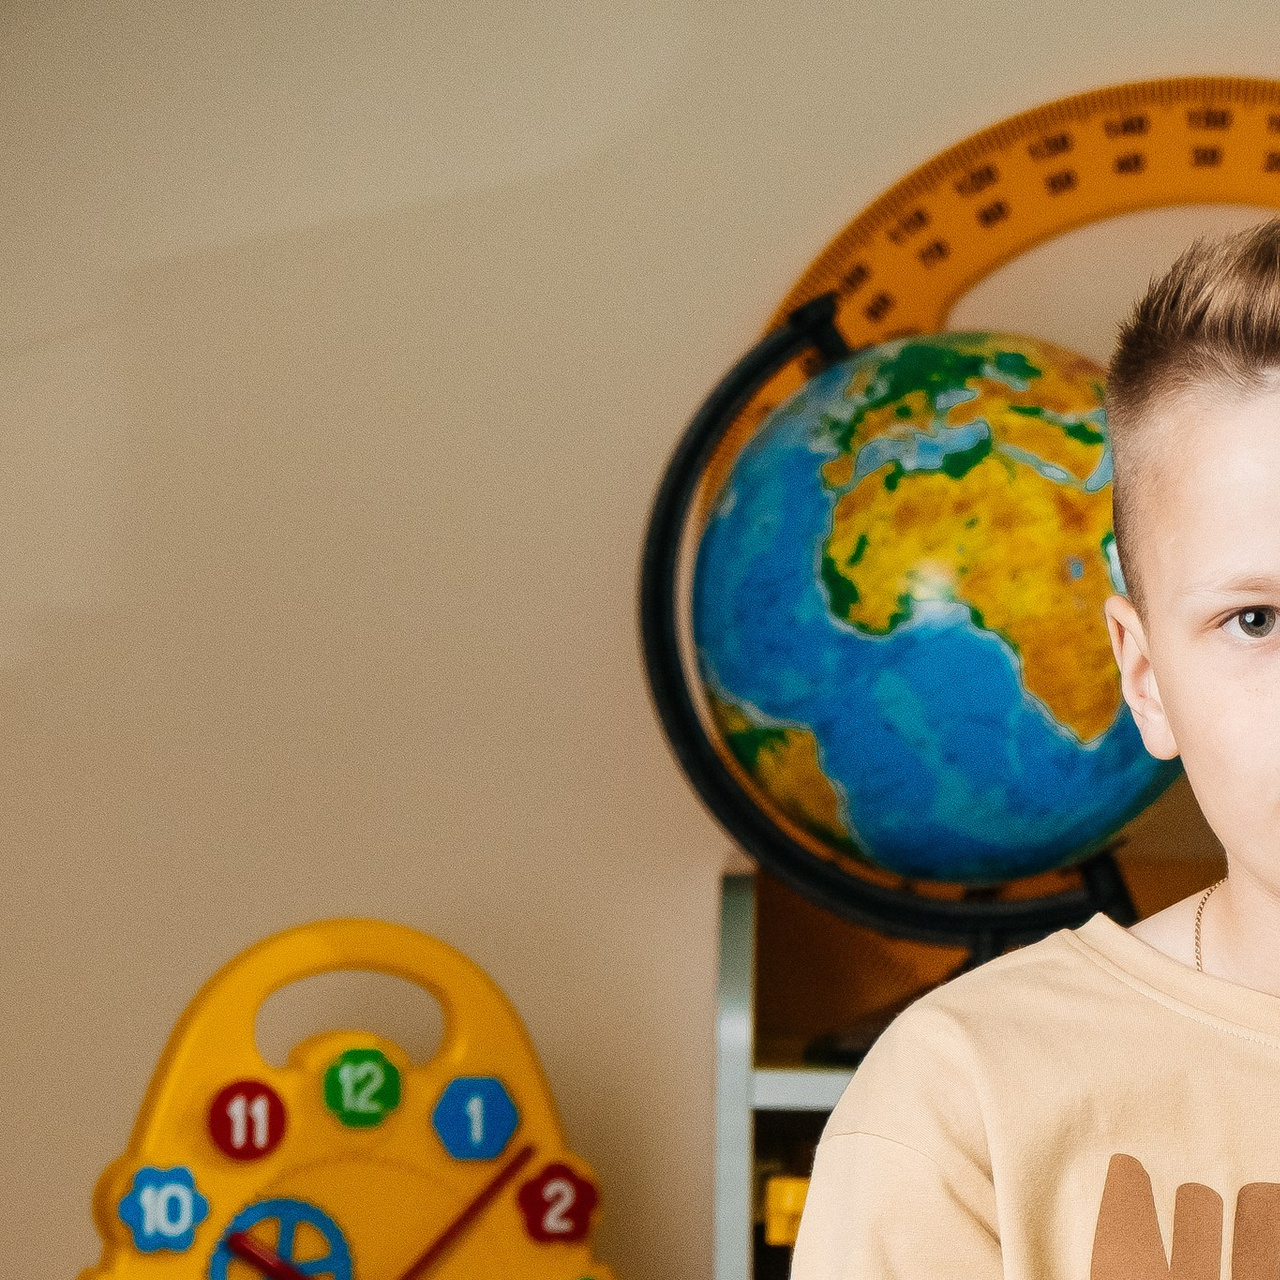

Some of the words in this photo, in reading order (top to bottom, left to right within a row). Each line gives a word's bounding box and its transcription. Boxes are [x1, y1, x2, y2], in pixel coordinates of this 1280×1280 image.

[339, 1061, 384, 1111] 12
[226, 1095, 269, 1148] 11
[466, 1096, 484, 1143] 1
[140, 1184, 193, 1236] 10
[541, 1178, 575, 1233] 2
